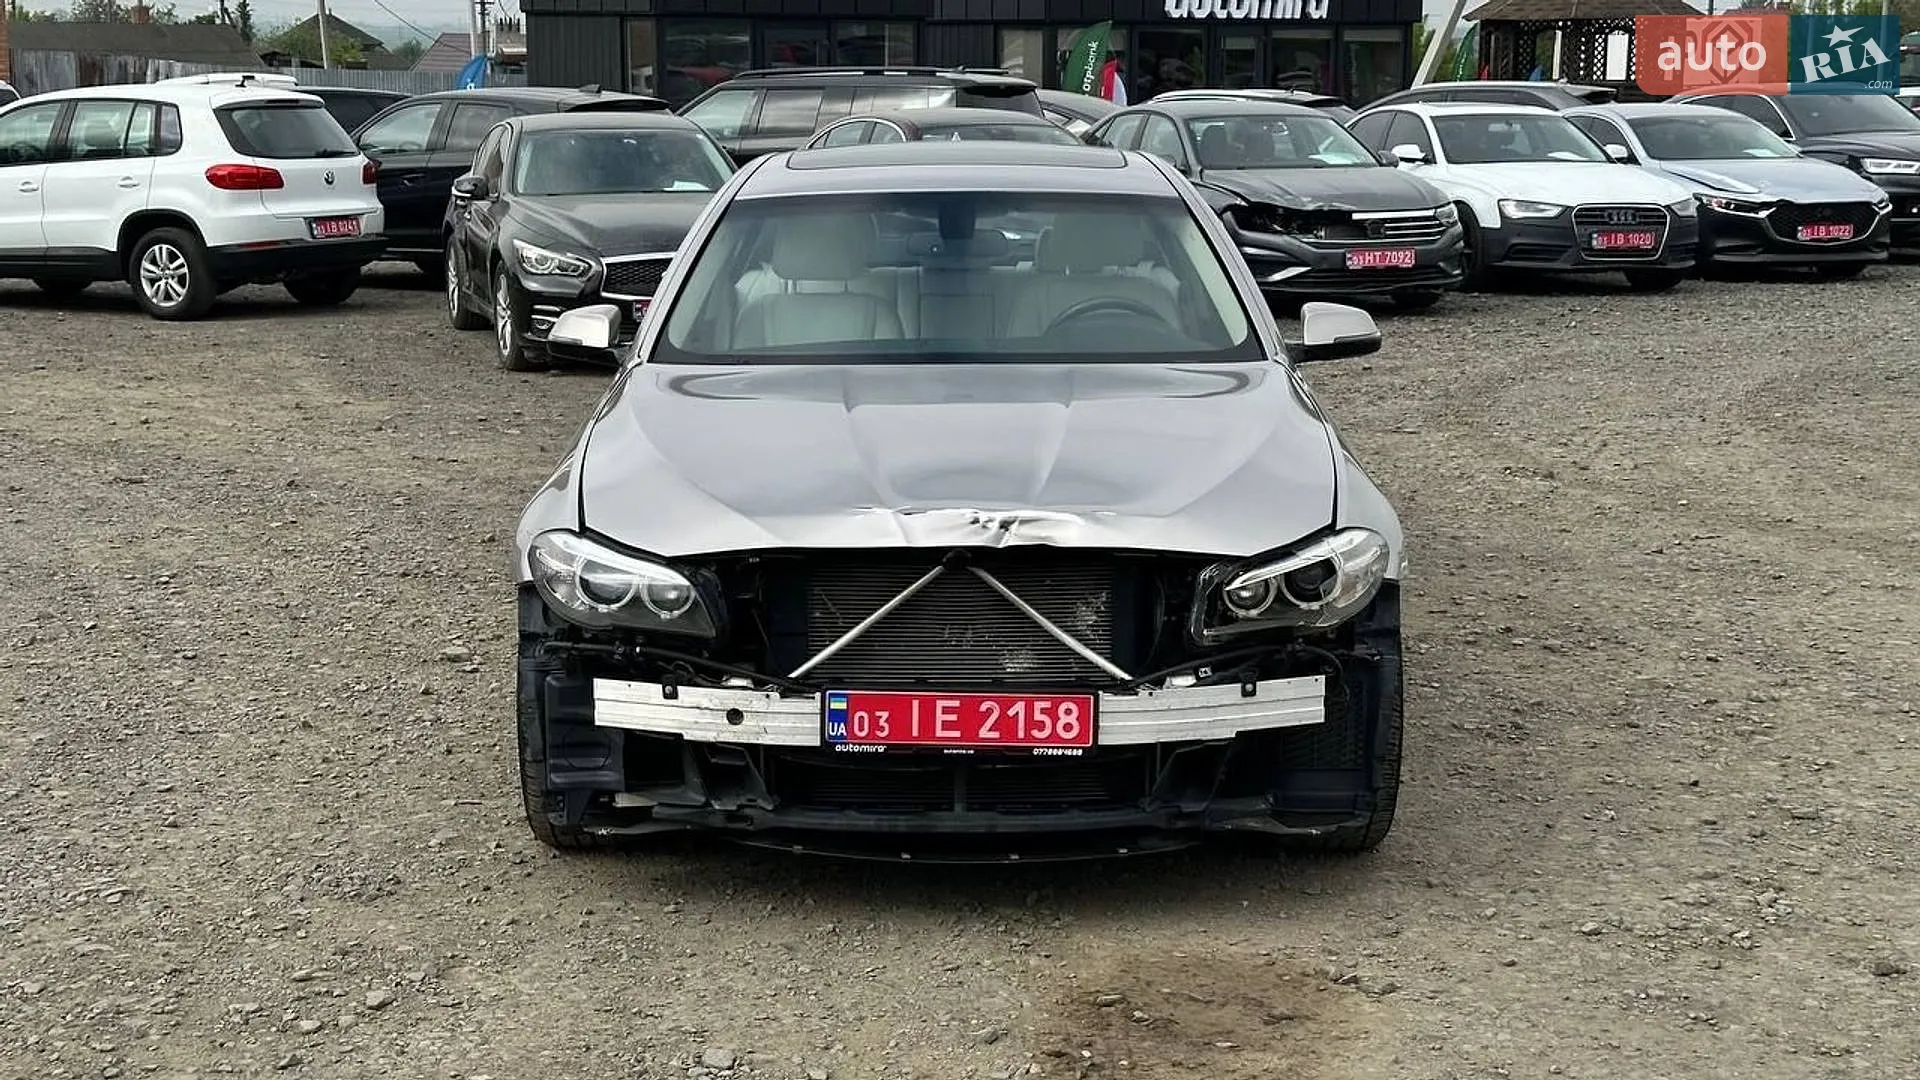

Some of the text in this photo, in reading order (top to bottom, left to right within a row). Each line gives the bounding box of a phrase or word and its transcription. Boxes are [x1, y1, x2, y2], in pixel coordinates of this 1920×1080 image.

[1365, 251, 1381, 264] HT
[1385, 251, 1412, 264] 7092
[829, 722, 847, 736] UA
[853, 711, 889, 738] 03
[978, 701, 1081, 739] 2158
